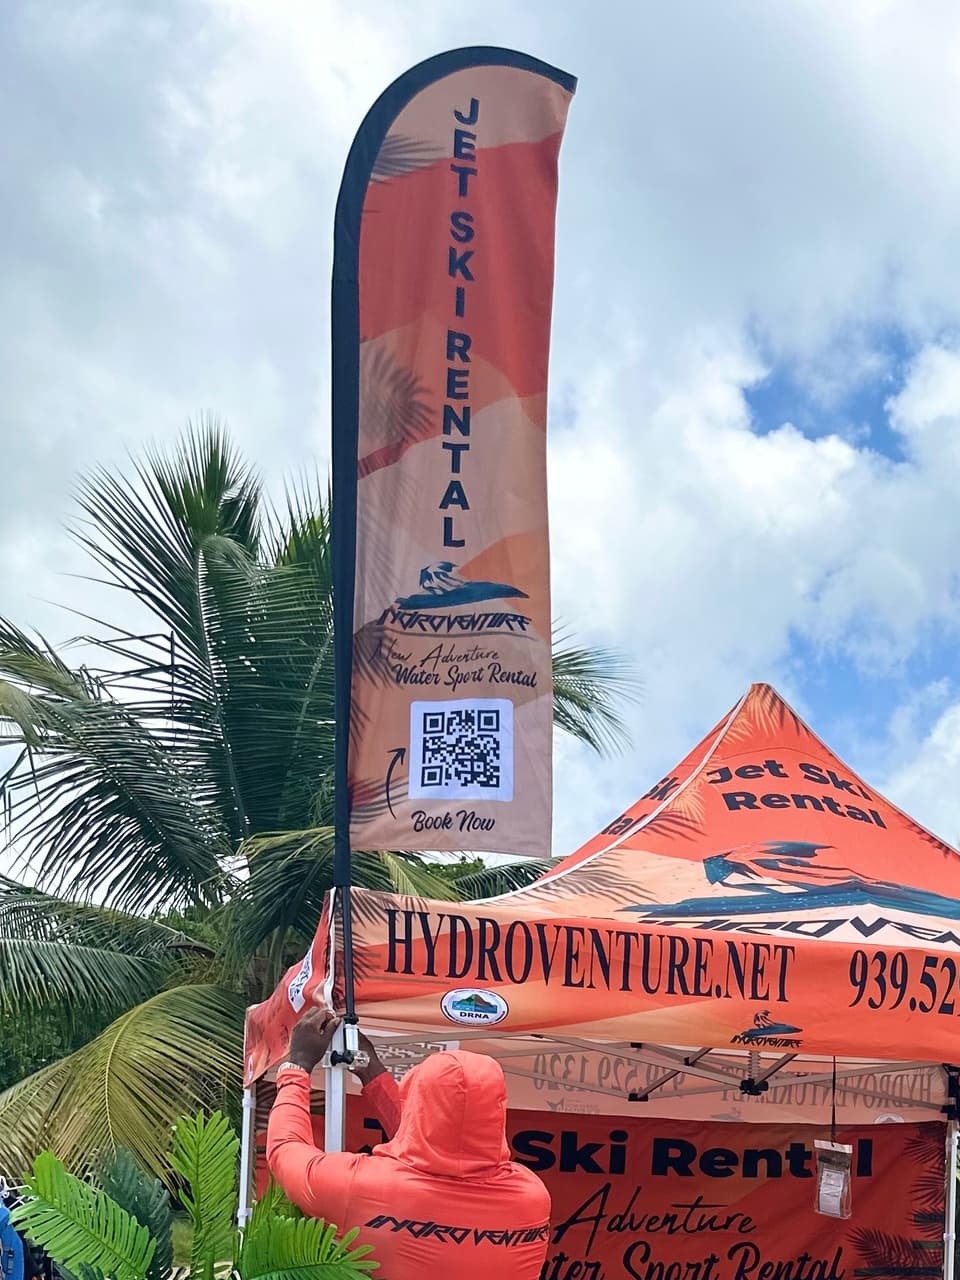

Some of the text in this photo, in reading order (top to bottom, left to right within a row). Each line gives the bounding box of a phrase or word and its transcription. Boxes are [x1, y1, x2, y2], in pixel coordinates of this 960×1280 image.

[439, 98, 480, 549] JET SKI RENTAL
[376, 609, 533, 633] HYDROVENTURE
[420, 642, 500, 672] Adventure
[392, 662, 538, 692] Water Sport Rental
[706, 759, 874, 802] Jet Ski
[410, 810, 497, 833] Book Now
[721, 791, 888, 830] Rental
[384, 908, 796, 1003] HYDROVENTURE.NET
[459, 1011, 490, 1020] DRNA
[511, 1130, 873, 1178] Ski Rentl
[551, 1182, 757, 1257] Adventure
